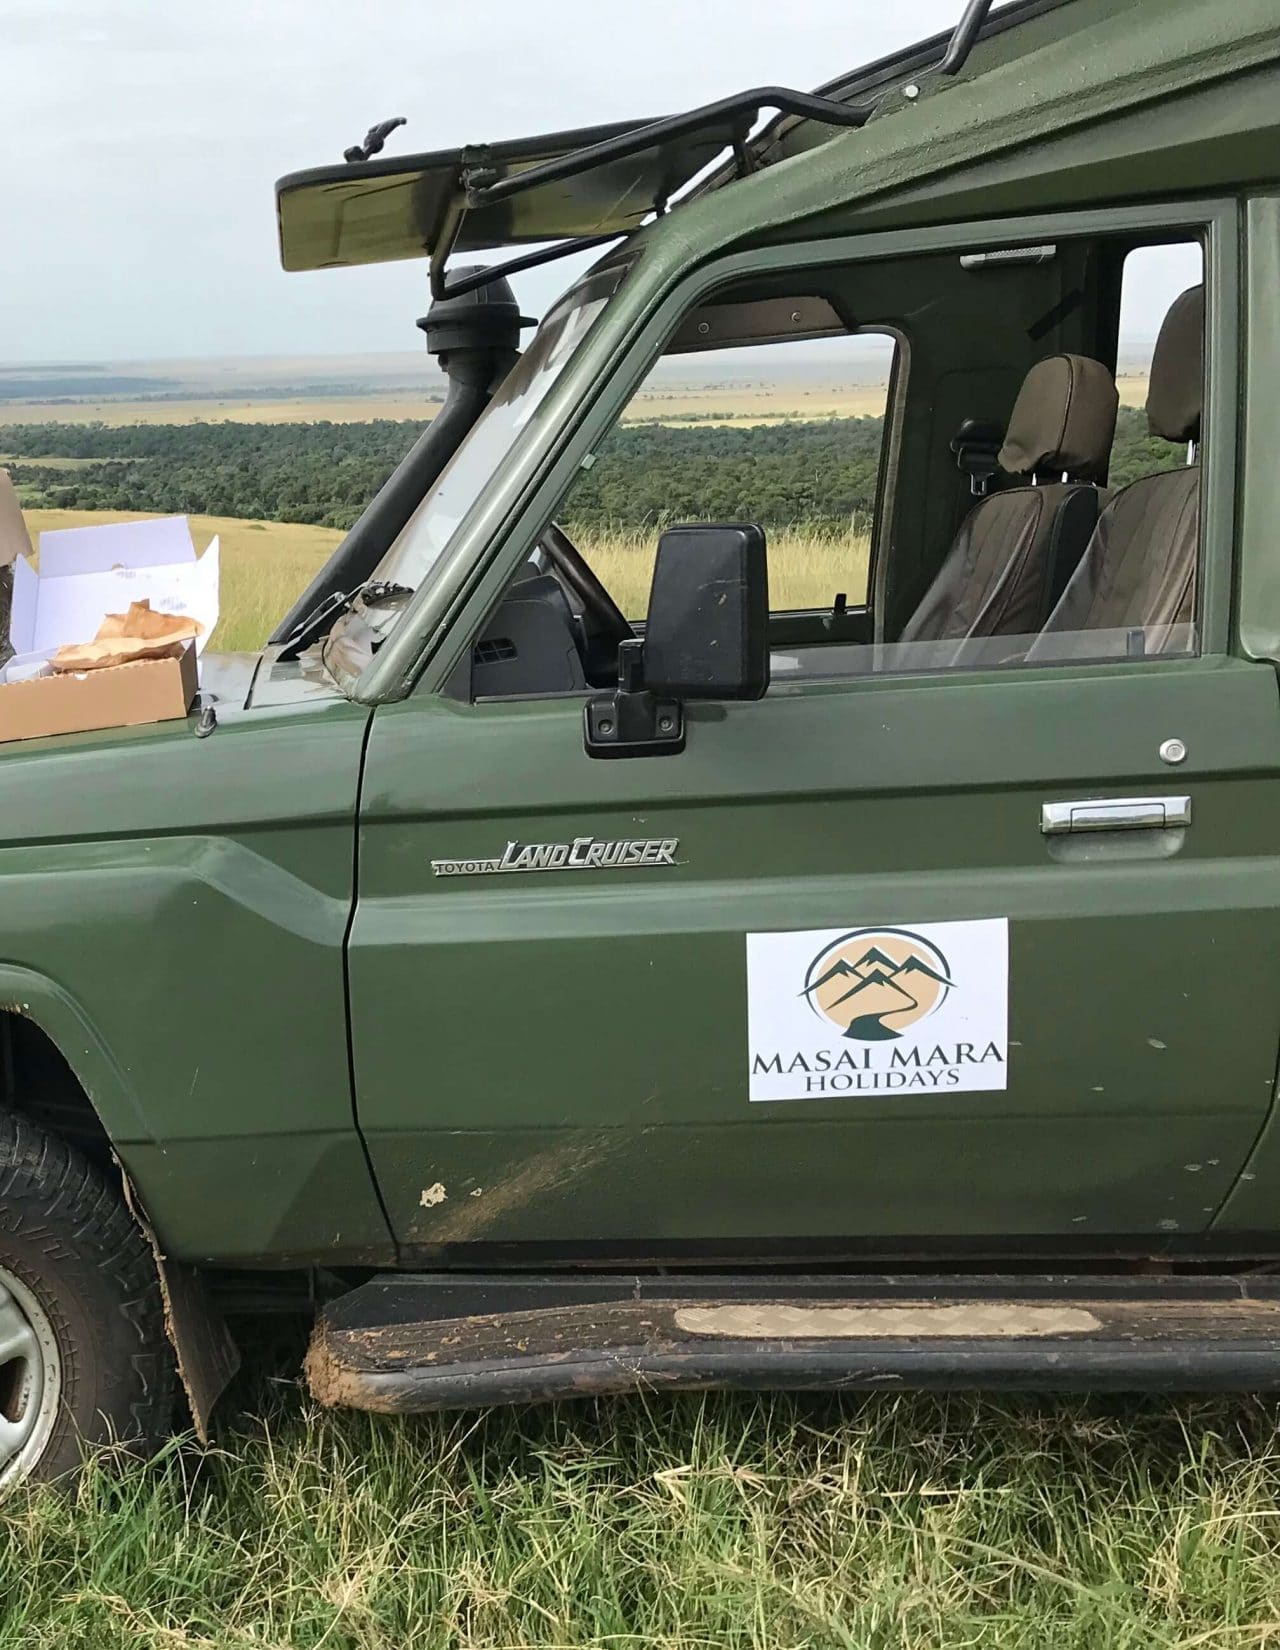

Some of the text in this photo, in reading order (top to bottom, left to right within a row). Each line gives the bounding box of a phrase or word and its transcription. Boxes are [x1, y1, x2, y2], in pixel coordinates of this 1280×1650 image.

[436, 836, 680, 874] TOYOTA LAND CRUISER
[752, 1041, 1005, 1075] MASAI MARA
[805, 1069, 960, 1092] HOLIDAYS
